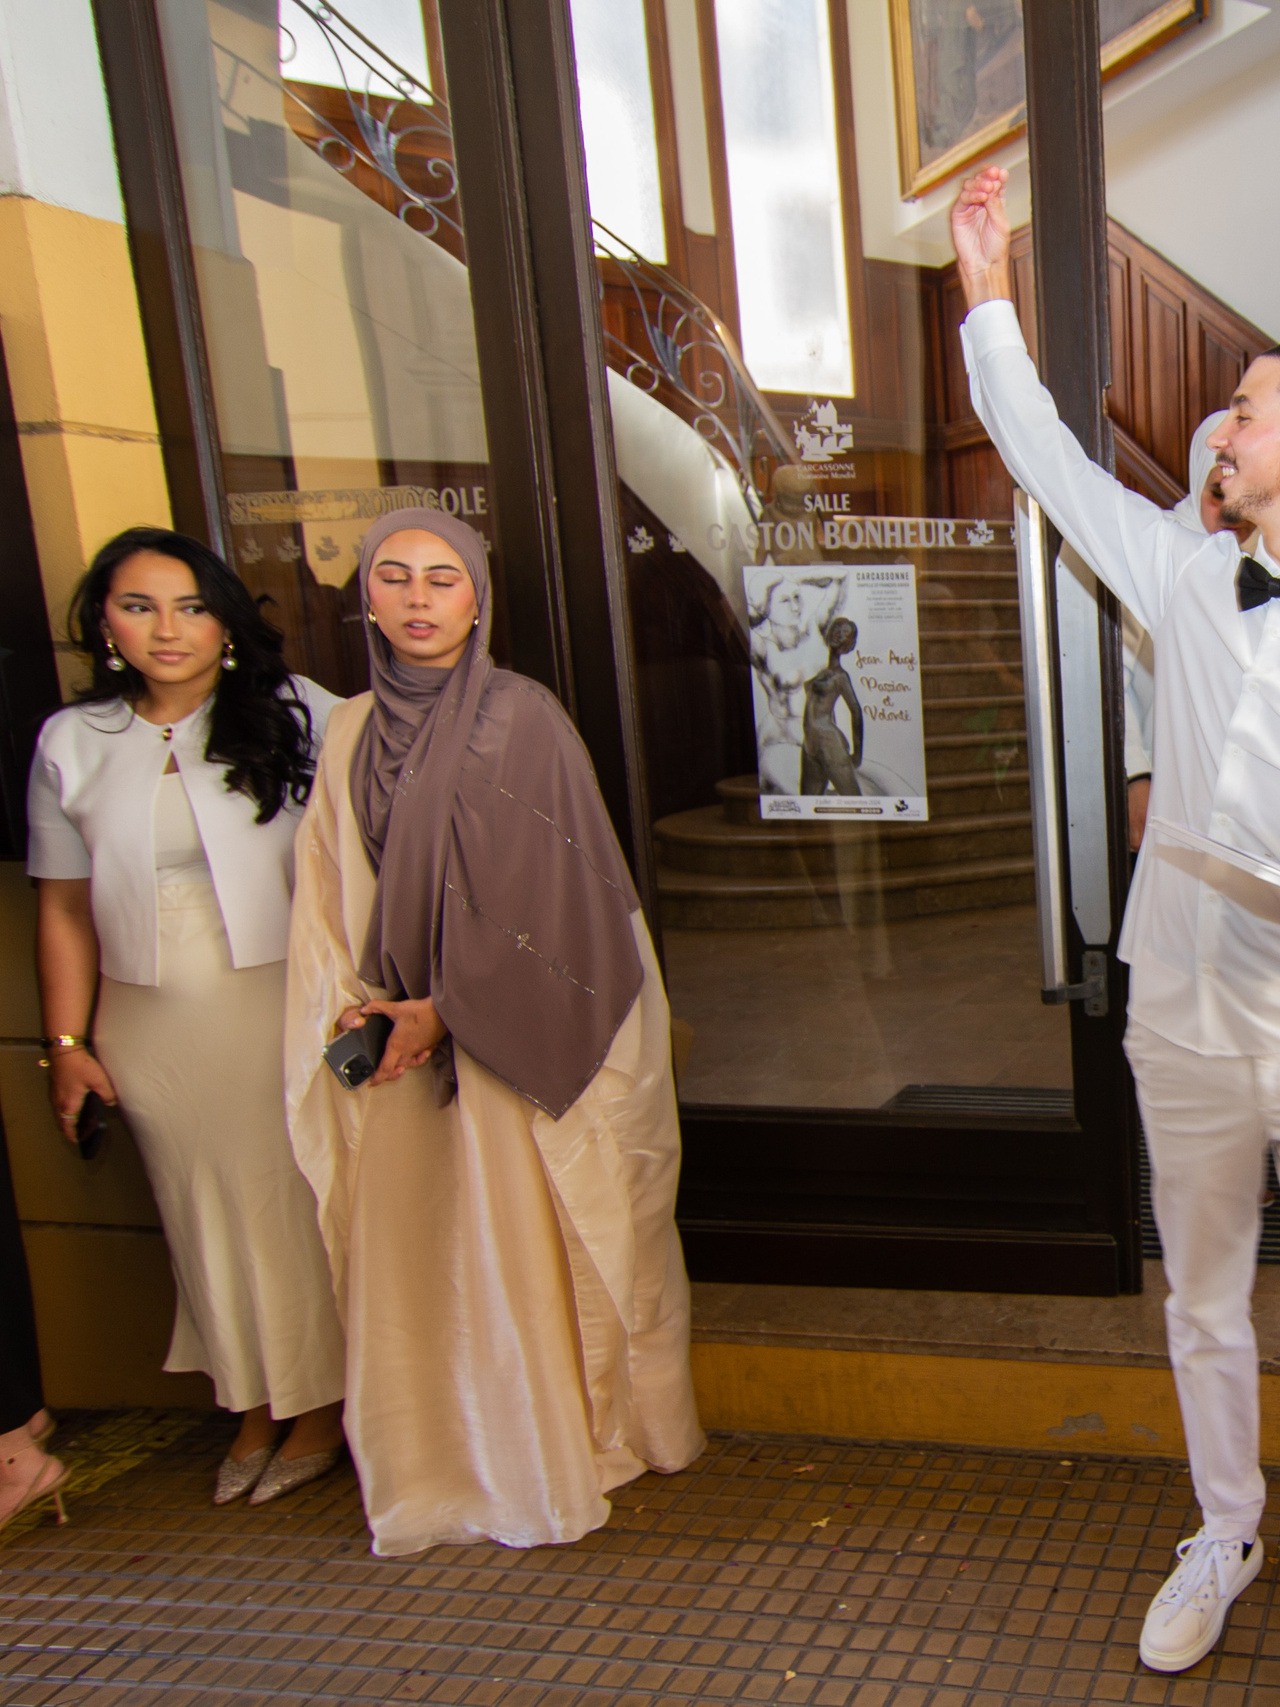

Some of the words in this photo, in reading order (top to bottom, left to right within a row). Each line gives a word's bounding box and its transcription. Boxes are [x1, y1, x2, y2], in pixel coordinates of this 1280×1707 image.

[804, 493, 851, 512] SALLE
[707, 521, 815, 551] GASTON
[823, 519, 956, 550] BONHEUR
[856, 571, 910, 581] CARCASSONNE
[855, 649, 882, 669] Jean
[860, 676, 912, 693] Passion
[863, 705, 912, 721] Volonté
